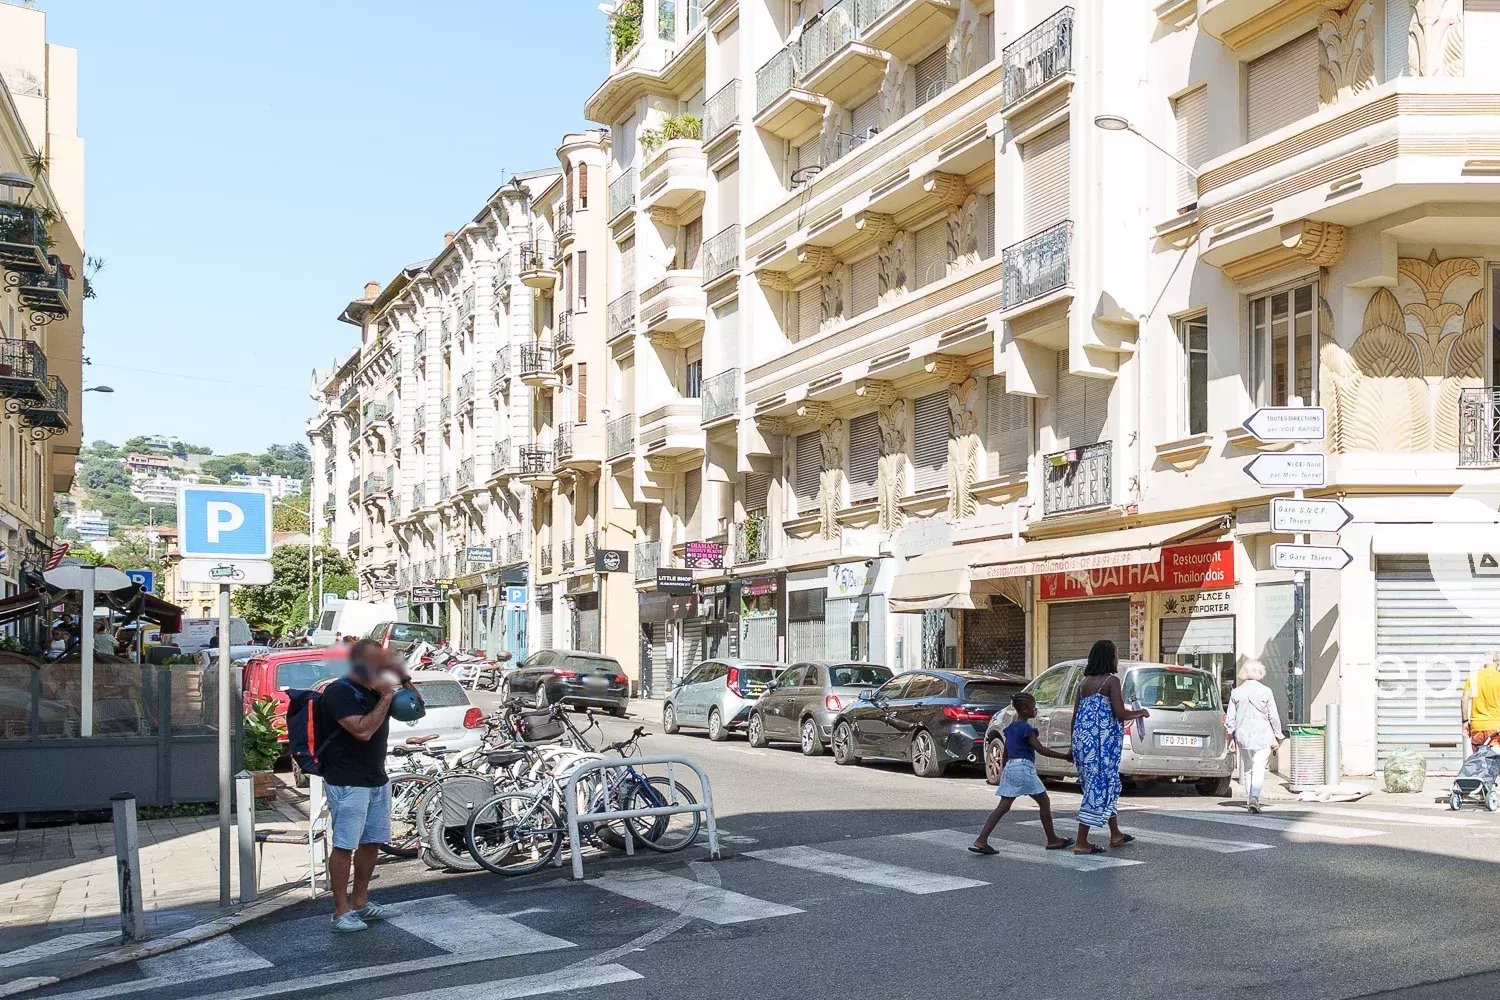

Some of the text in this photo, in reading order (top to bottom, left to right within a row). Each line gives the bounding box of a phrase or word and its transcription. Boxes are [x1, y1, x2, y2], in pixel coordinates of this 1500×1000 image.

[207, 501, 245, 543] P
[1173, 550, 1221, 565] Restaurant
[986, 563, 1026, 577] Restaurant
[1173, 567, 1225, 584] Thailandais
[513, 589, 521, 600] P
[1180, 594, 1195, 602] SUR
[1197, 592, 1223, 601] PLACE
[1189, 603, 1230, 613] EMPORTER
